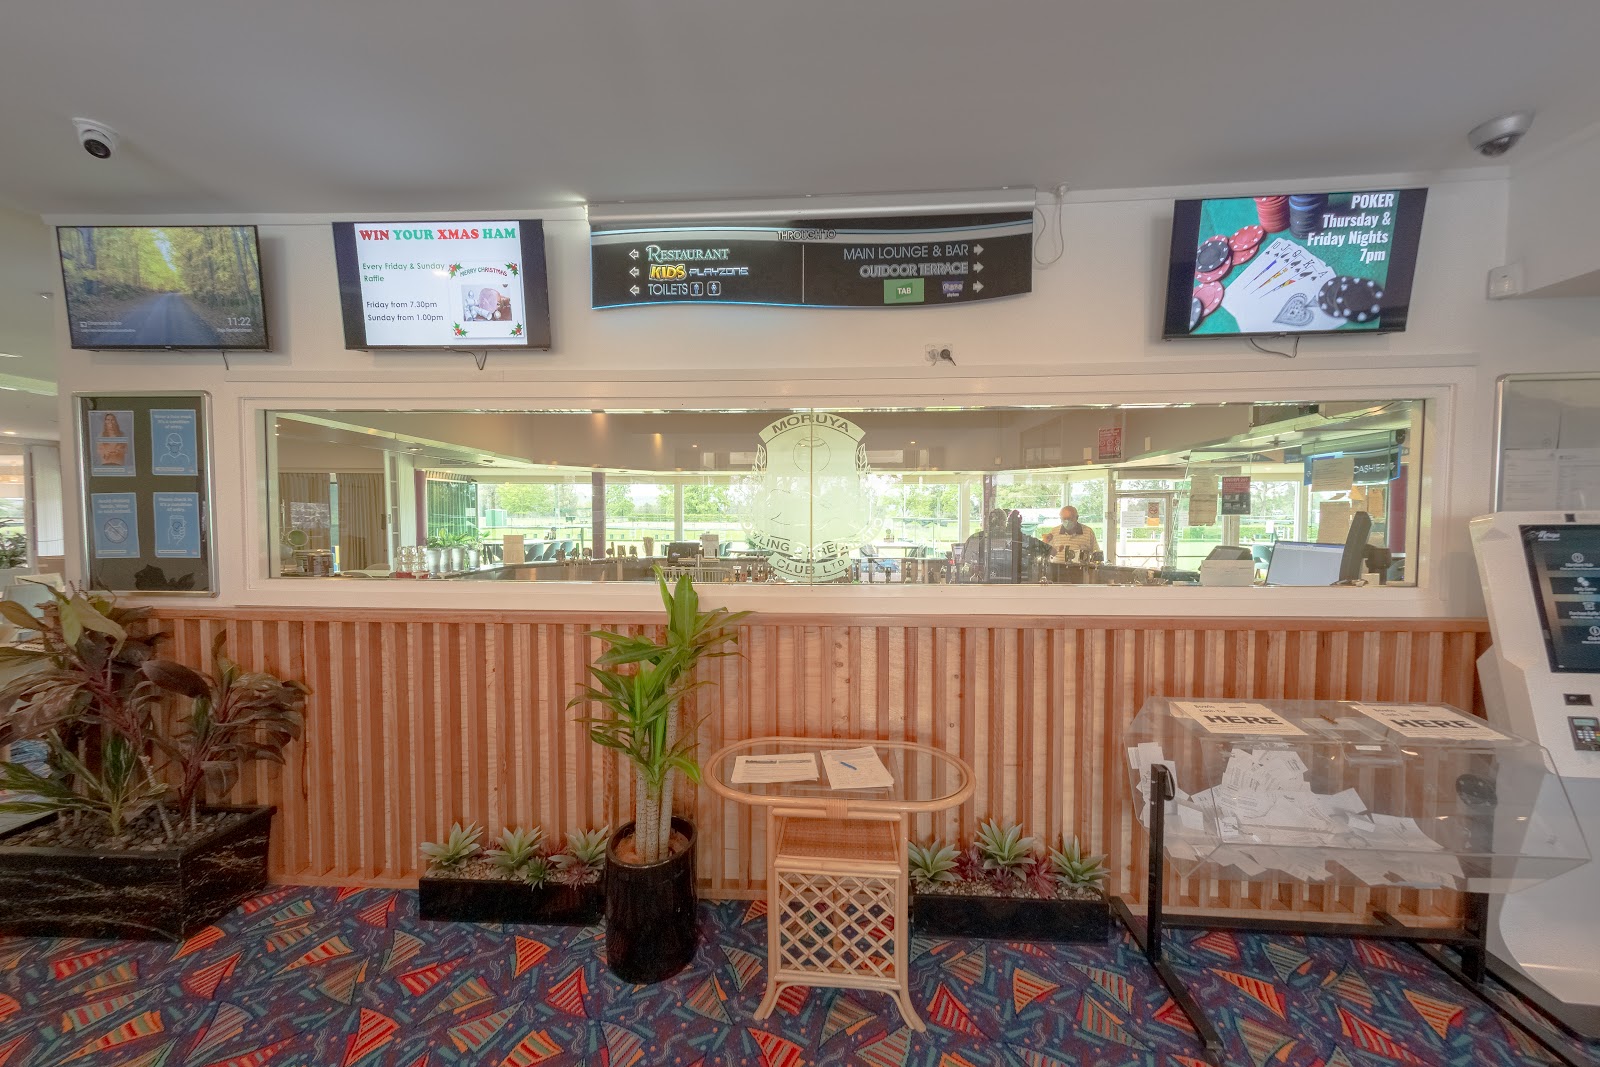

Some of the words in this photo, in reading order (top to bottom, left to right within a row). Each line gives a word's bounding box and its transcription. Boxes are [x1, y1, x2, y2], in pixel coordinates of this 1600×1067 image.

[1351, 194, 1395, 210] POKER
[1322, 213, 1380, 229] Thursday
[1382, 212, 1391, 226] &
[359, 229, 389, 241] WIN
[392, 229, 434, 240] YOUR
[437, 228, 479, 240] XMAS
[482, 227, 516, 239] HAM
[777, 229, 822, 241] THROUGH
[1307, 232, 1344, 247] Friday
[1349, 230, 1388, 245] Nights
[843, 248, 875, 260] MAIN
[878, 245, 928, 259] LOUNGE
[932, 244, 942, 257] &
[945, 243, 969, 257] BAR
[1360, 248, 1385, 264] 7pm
[362, 262, 382, 272] Every
[384, 262, 407, 271] Friday
[409, 262, 415, 270] &
[416, 261, 445, 271] Sunday
[460, 266, 477, 277] MERRY
[477, 266, 508, 277] CHRISTMAS
[649, 264, 686, 280] KIDS
[689, 266, 749, 276] PLAYZONE
[859, 263, 918, 278] OUTDOOR
[918, 261, 969, 276] TERRACE
[364, 274, 385, 282] Raffle
[648, 282, 688, 296] TOILETS
[897, 287, 912, 295] TAB
[366, 301, 389, 310] Friday
[409, 300, 438, 309] 7.30pm
[226, 316, 251, 326] 11:22
[367, 313, 395, 323] Sunday
[397, 313, 415, 321] from
[416, 313, 444, 322] 1.00pm
[772, 414, 850, 434] MORUYA
[776, 558, 816, 575] CLUB
[823, 559, 845, 574] LTD
[1204, 715, 1283, 725] HERE
[1390, 719, 1479, 729] HERE
